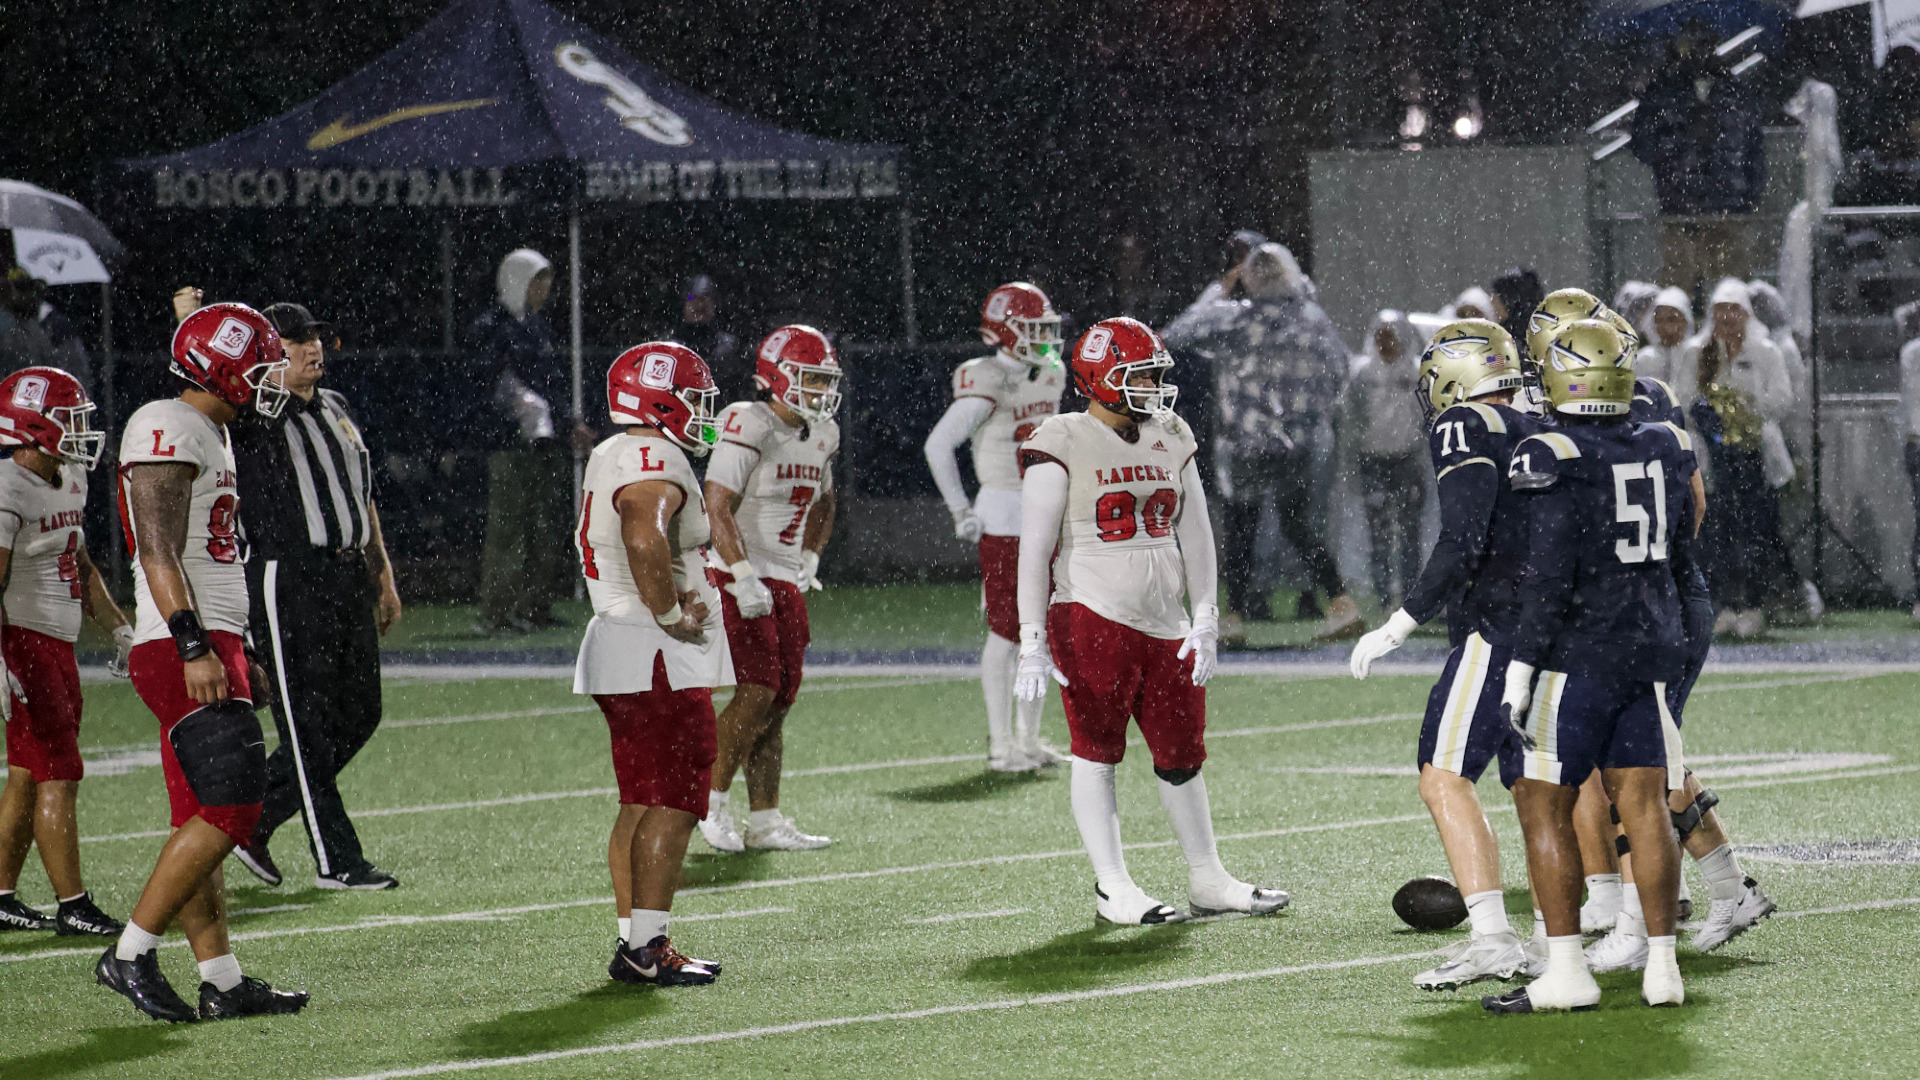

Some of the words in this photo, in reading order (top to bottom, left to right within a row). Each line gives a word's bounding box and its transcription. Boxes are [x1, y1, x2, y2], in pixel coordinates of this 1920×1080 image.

[156, 167, 286, 207] BOSCO
[296, 167, 517, 206] FOOTBALL
[959, 369, 974, 389] L
[1012, 401, 1055, 421] LANCER
[1580, 404, 1617, 413] BRAVES
[725, 411, 742, 435] L
[150, 429, 175, 457] L
[1435, 421, 1470, 457] 71
[639, 446, 664, 472] L
[776, 463, 821, 482] LANCER
[779, 485, 815, 546] 7
[1096, 488, 1178, 542] 90
[1611, 459, 1668, 564] 51
[67, 915, 101, 933] BATTLE
